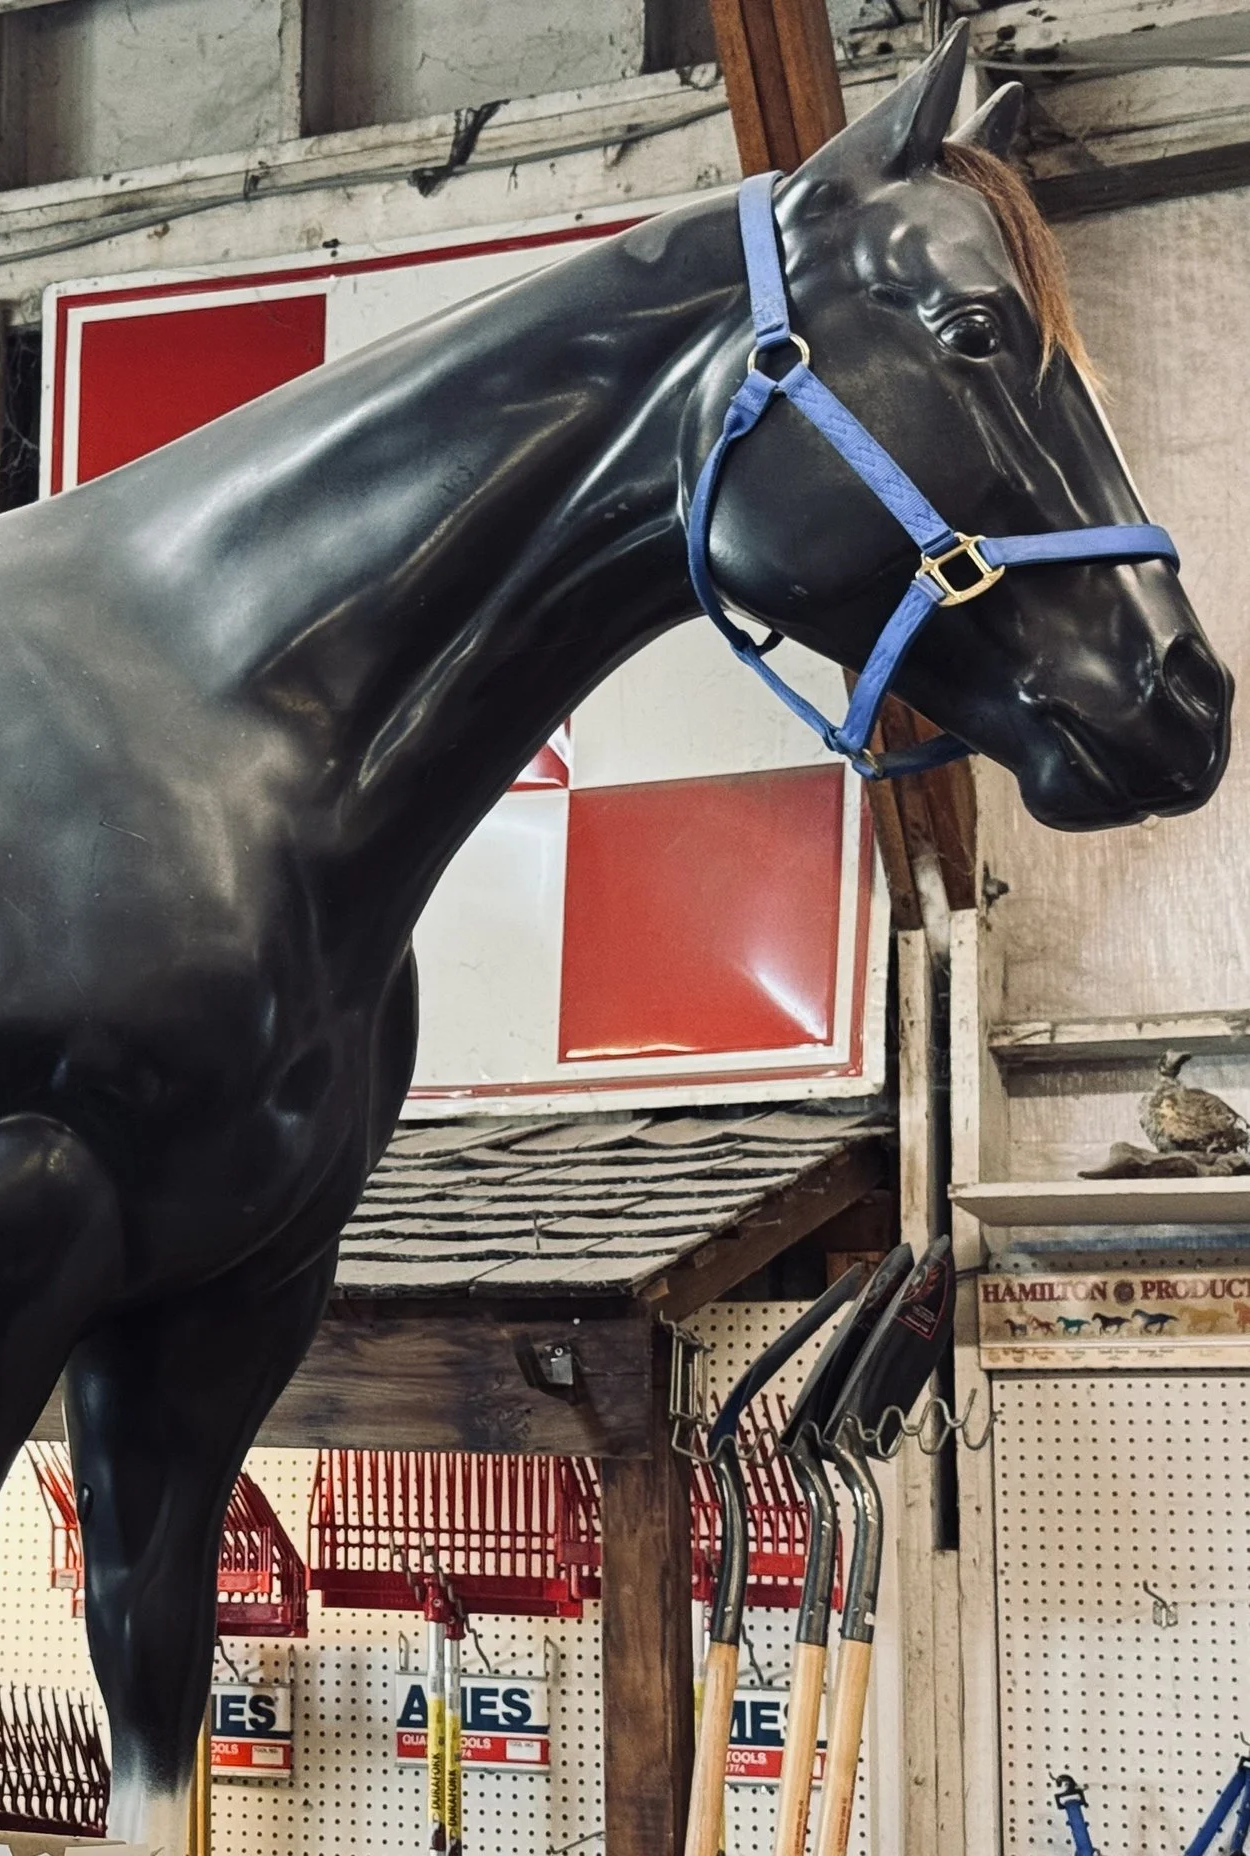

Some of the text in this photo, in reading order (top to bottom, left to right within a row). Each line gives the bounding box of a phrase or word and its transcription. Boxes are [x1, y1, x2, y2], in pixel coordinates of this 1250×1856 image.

[982, 1281, 1107, 1302] HAMILTON
[398, 1685, 532, 1726] AES
[211, 1743, 239, 1755] OOLS
[461, 1738, 491, 1749] OOLS
